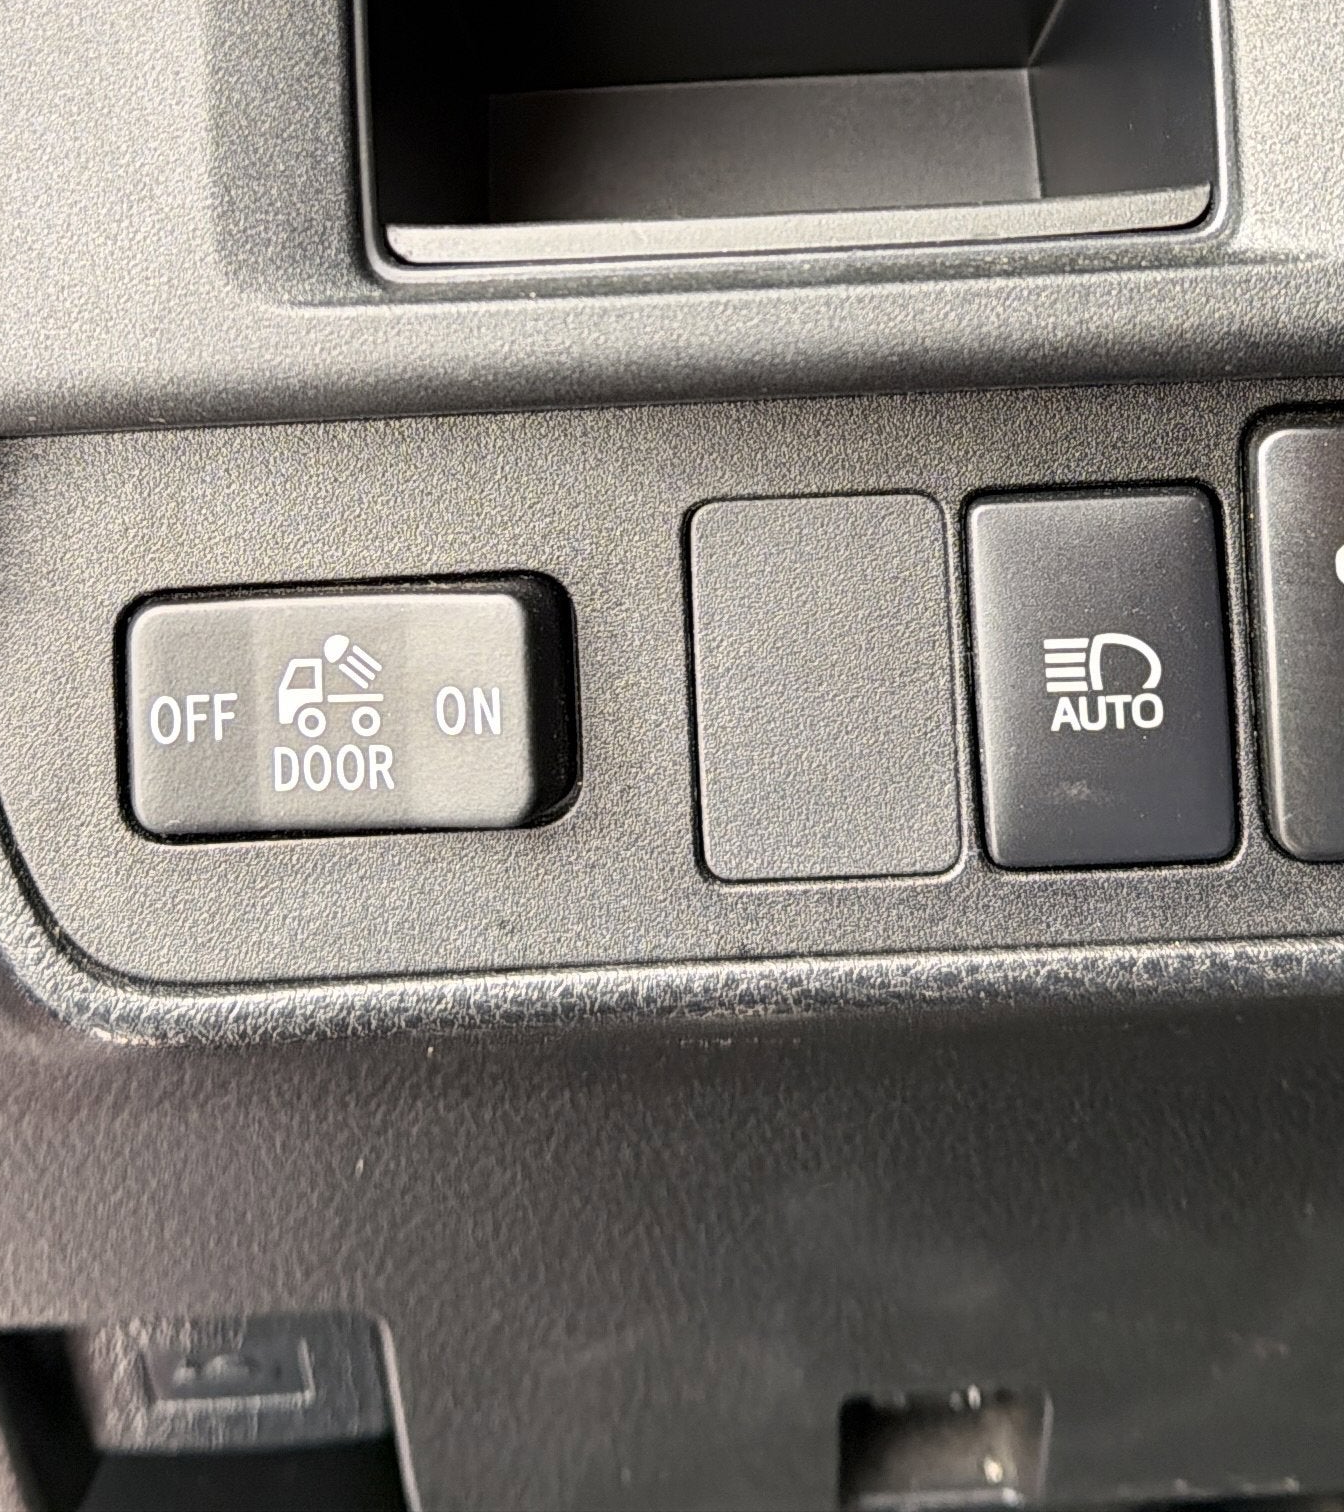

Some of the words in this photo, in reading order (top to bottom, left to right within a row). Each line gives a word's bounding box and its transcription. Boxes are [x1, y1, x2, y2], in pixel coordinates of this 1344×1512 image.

[150, 692, 239, 745] OFF
[435, 685, 503, 736] ON
[1050, 692, 1165, 732] AUTO
[272, 743, 396, 792] DOOR
